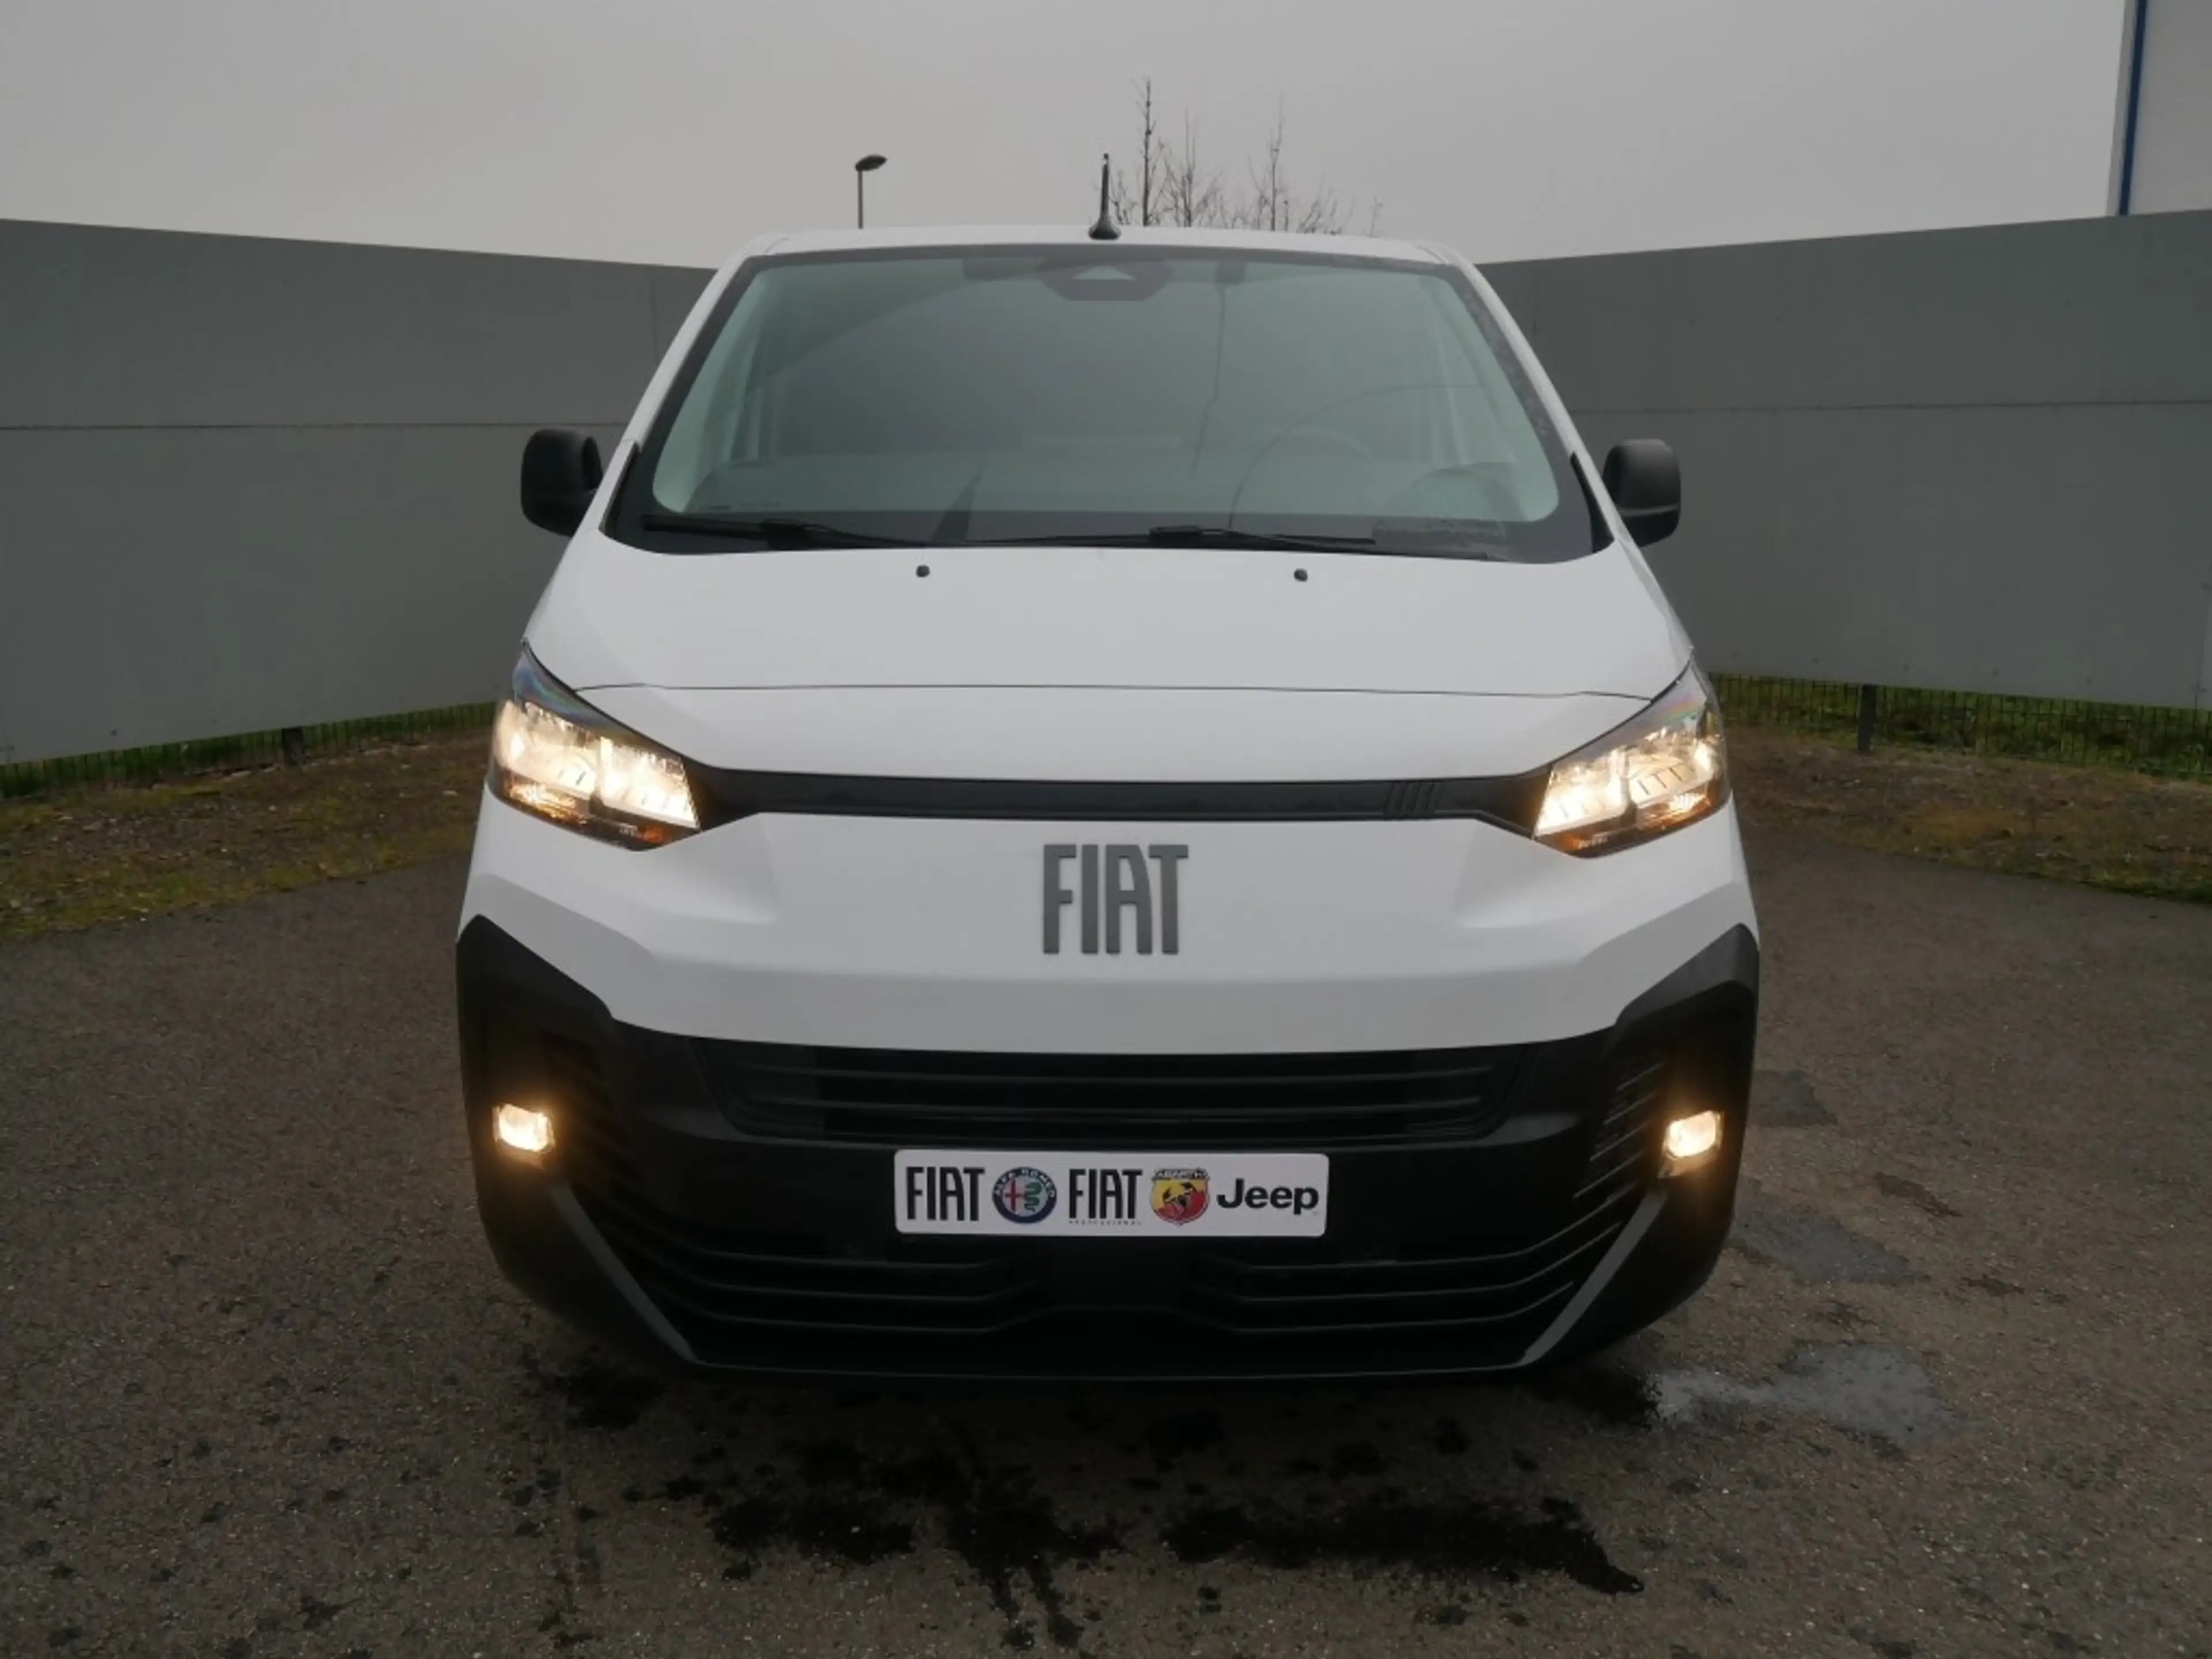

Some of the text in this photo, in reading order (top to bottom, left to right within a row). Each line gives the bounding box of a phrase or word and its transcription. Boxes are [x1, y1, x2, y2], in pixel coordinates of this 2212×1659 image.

[1043, 843, 1189, 955] FIAT
[906, 1166, 985, 1221] FIAT
[993, 1168, 1055, 1198] ALFA ROMEO
[1069, 1169, 1143, 1219] FIAT
[1217, 1179, 1319, 1215] Jeep
